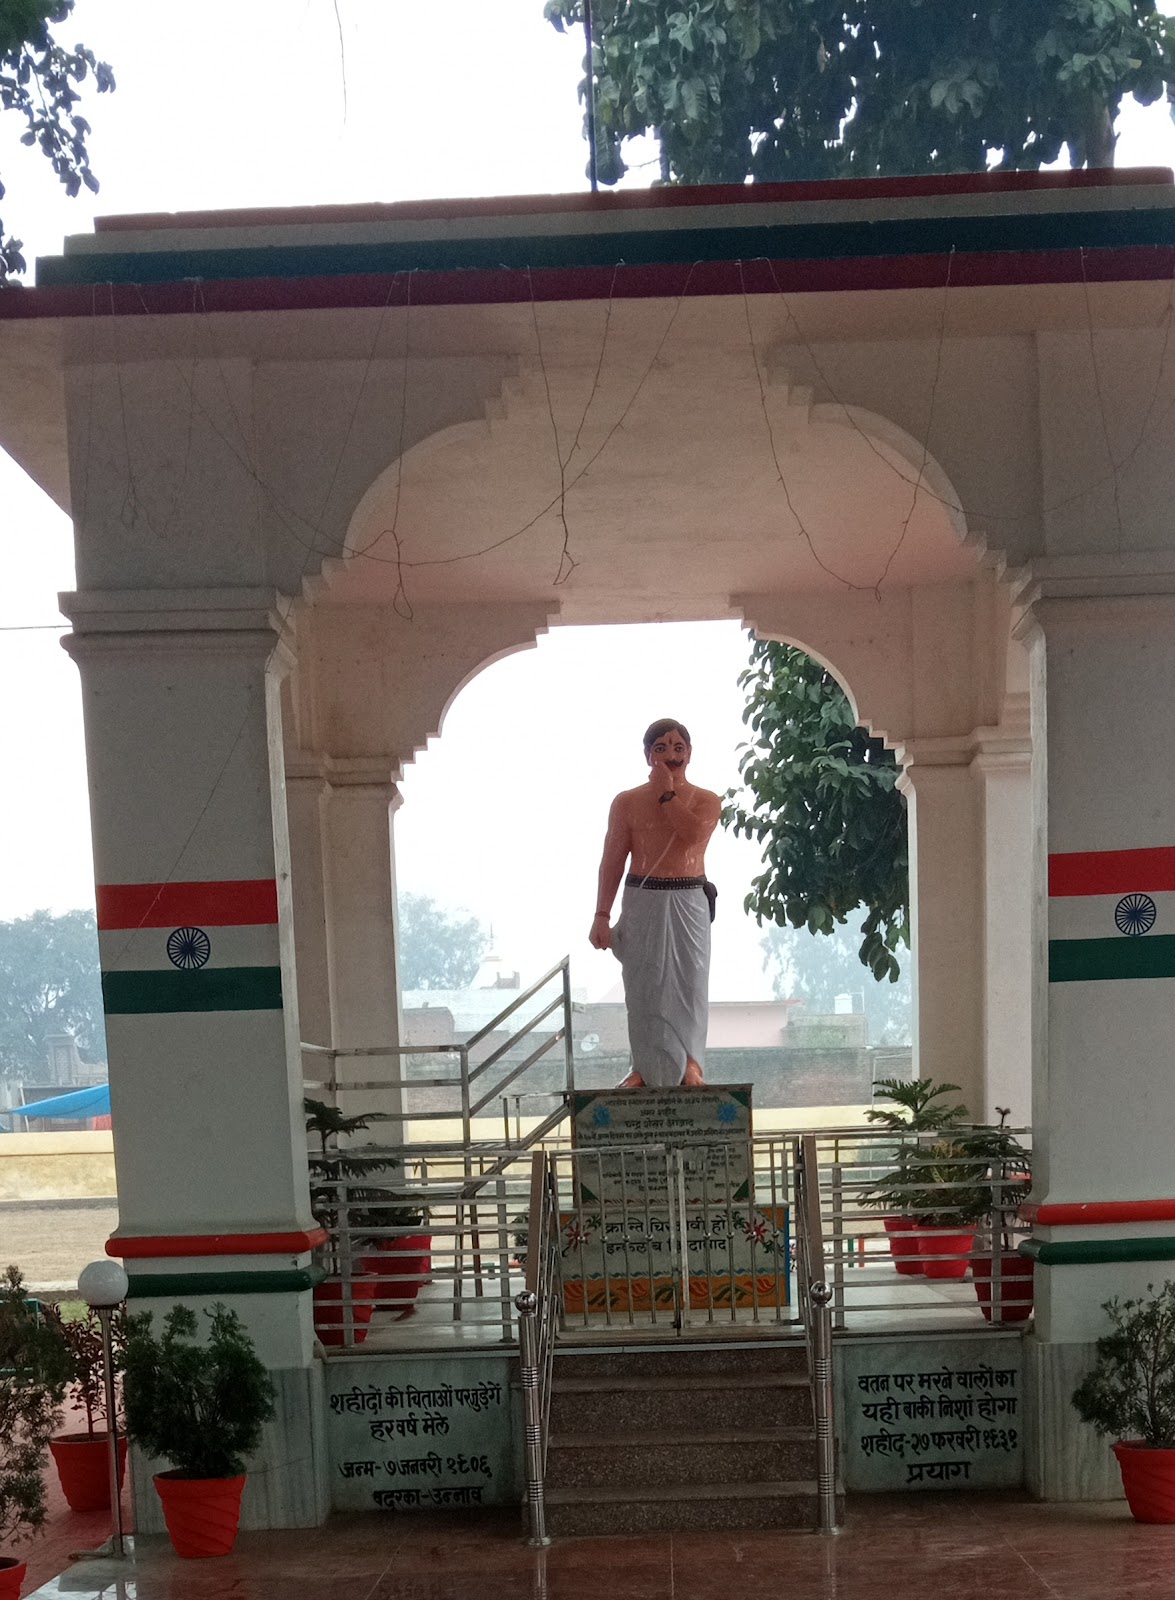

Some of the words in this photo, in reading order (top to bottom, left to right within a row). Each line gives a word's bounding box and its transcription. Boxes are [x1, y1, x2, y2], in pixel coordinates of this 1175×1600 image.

[644, 1117, 664, 1129] शेखर
[657, 1106, 677, 1117] शहीद
[711, 1215, 726, 1235] हो
[606, 1241, 662, 1256] इन्कलब
[858, 1374, 891, 1394] वतन
[893, 1373, 916, 1394] पर
[918, 1366, 954, 1392] मरने
[956, 1364, 995, 1390] वालों
[995, 1369, 1017, 1387] का
[330, 1384, 382, 1415] शहीदों
[385, 1385, 403, 1409] की
[406, 1383, 453, 1410] चिताओं
[862, 1396, 901, 1425] यही
[903, 1394, 935, 1419] बाकी
[938, 1394, 973, 1421] निशां
[976, 1391, 1018, 1422] होगा
[369, 1419, 395, 1443] हर
[396, 1411, 420, 1437] वर्ष
[422, 1411, 450, 1436] मेले
[931, 1424, 981, 1452] फरवरी
[397, 1451, 442, 1478] जनवरी
[906, 1461, 972, 1483] प्रयाग
